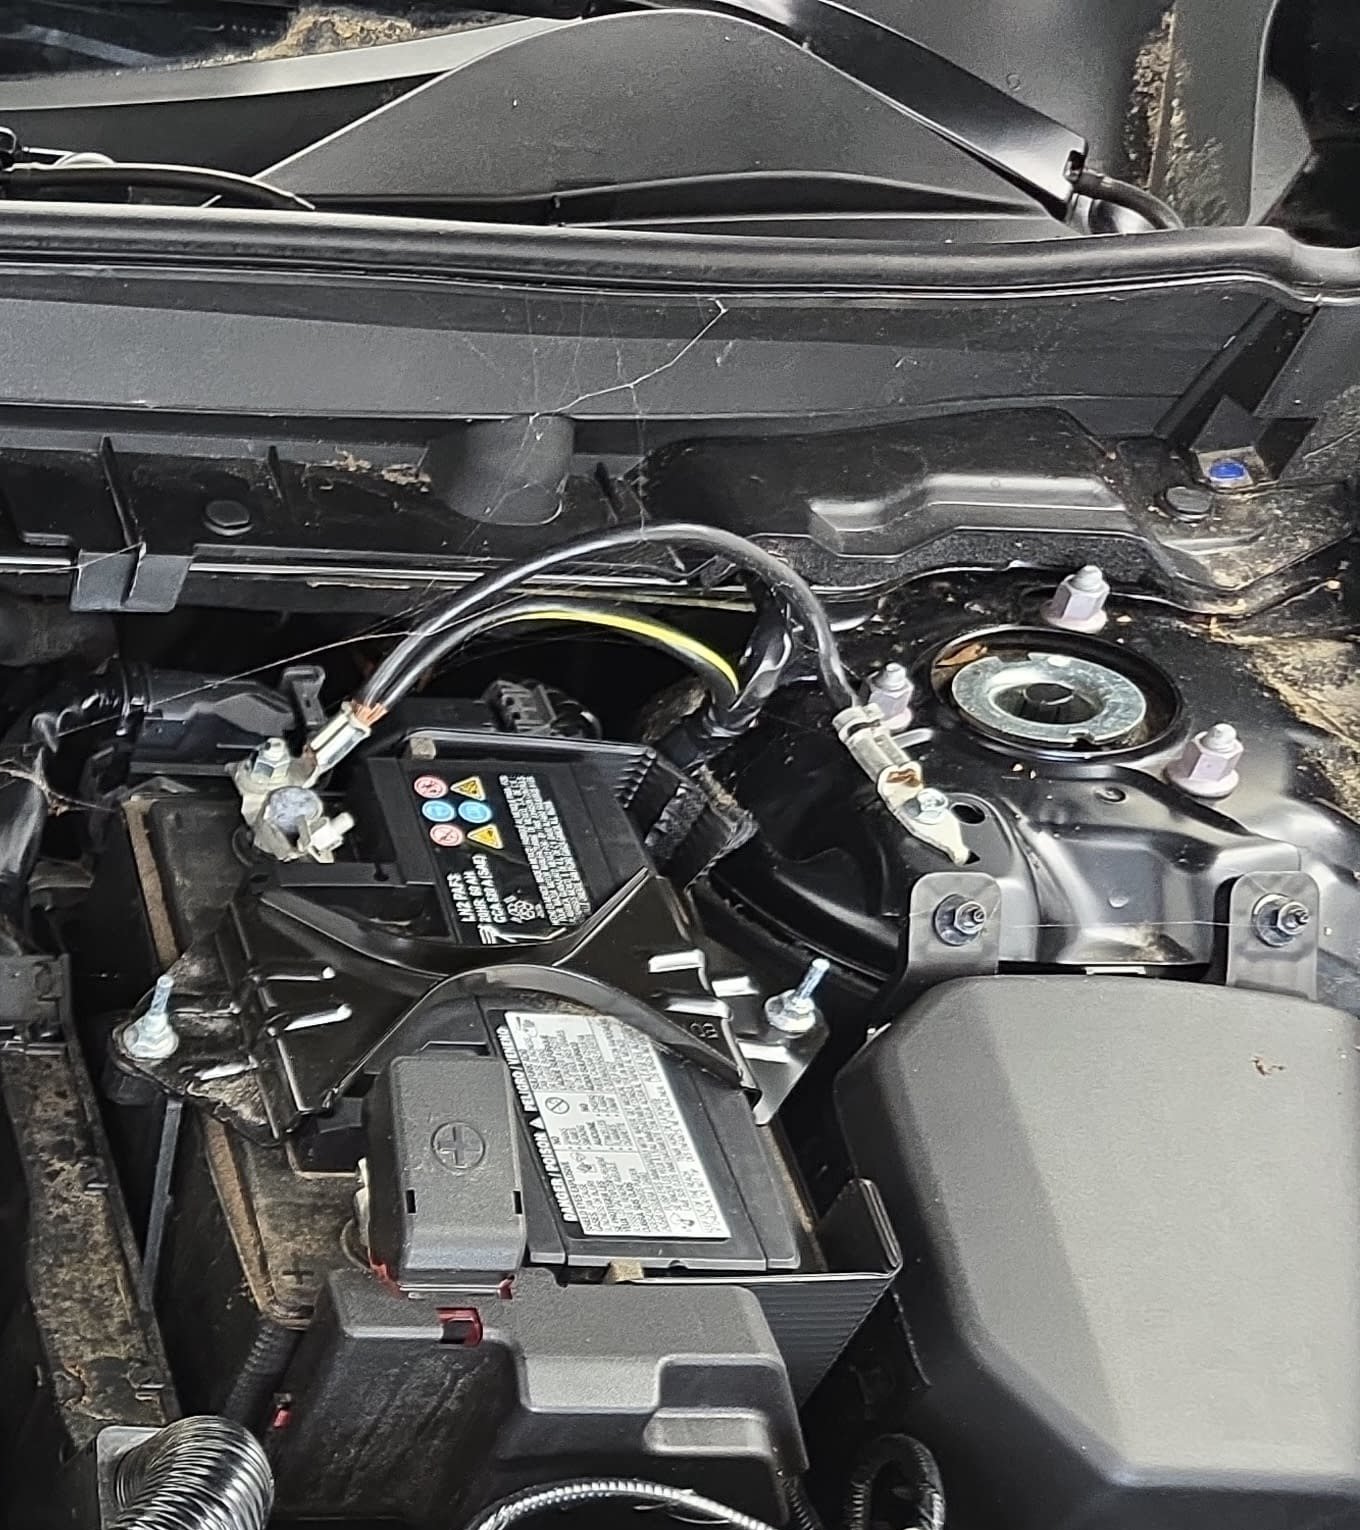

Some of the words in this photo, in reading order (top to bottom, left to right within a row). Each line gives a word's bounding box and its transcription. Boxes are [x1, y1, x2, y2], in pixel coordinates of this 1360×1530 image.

[511, 1071, 537, 1111] PELIGRO
[532, 1132, 559, 1171] POISON
[549, 1178, 578, 1222] DANGER
